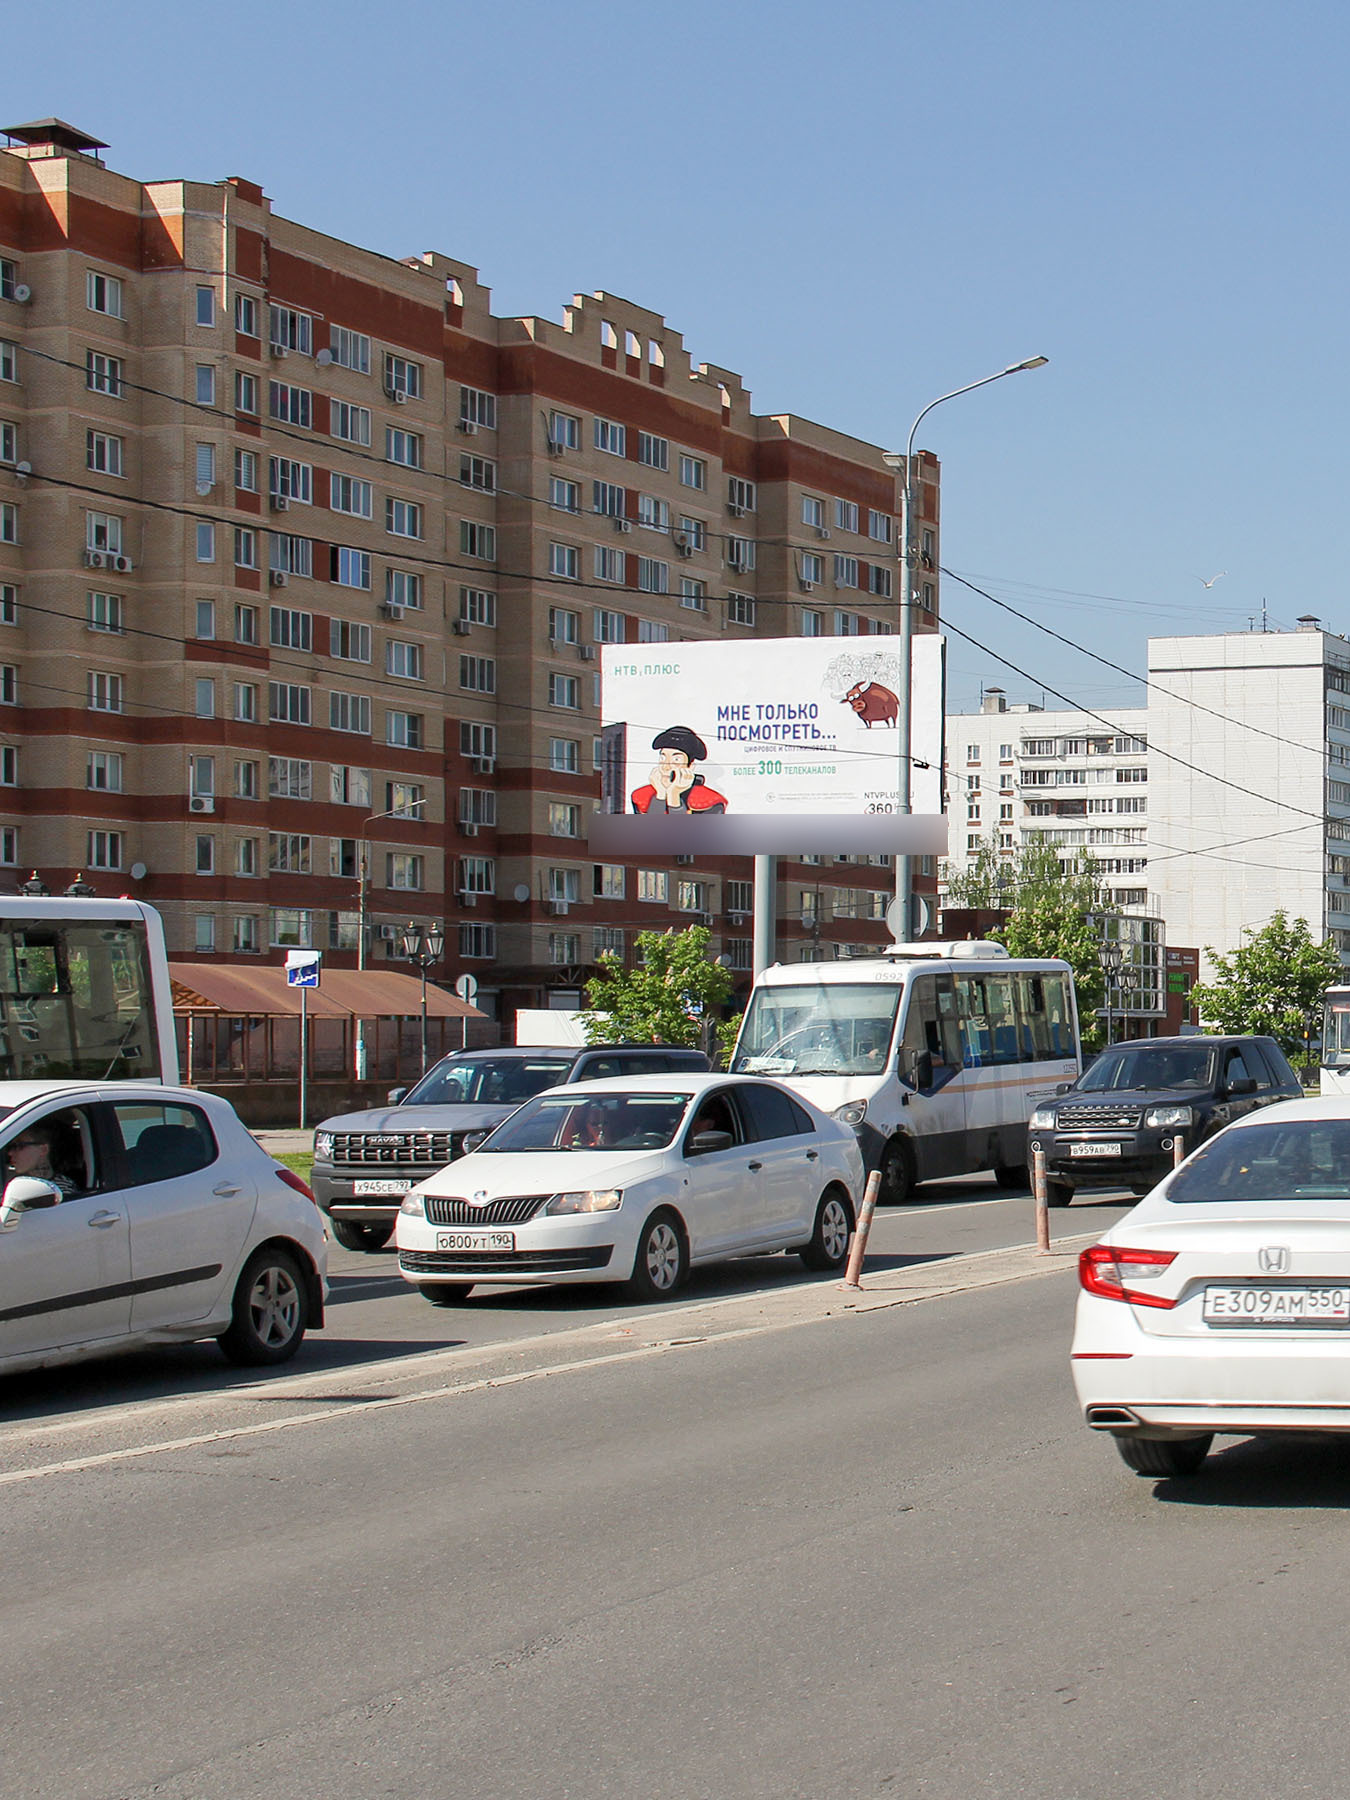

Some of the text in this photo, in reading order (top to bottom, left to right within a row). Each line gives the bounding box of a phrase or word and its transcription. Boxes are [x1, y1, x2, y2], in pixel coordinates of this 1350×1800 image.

[717, 703, 819, 721] МНЕ ТОЛЬКО
[717, 723, 837, 741] ПОСМОТРЕТЬ...
[732, 760, 837, 776] БОЛЕЕ 300 ТЕЛЕКАНАЛОВ
[875, 972, 904, 981] 0592
[490, 1234, 509, 1244] 190
[1308, 1290, 1343, 1307] 550
